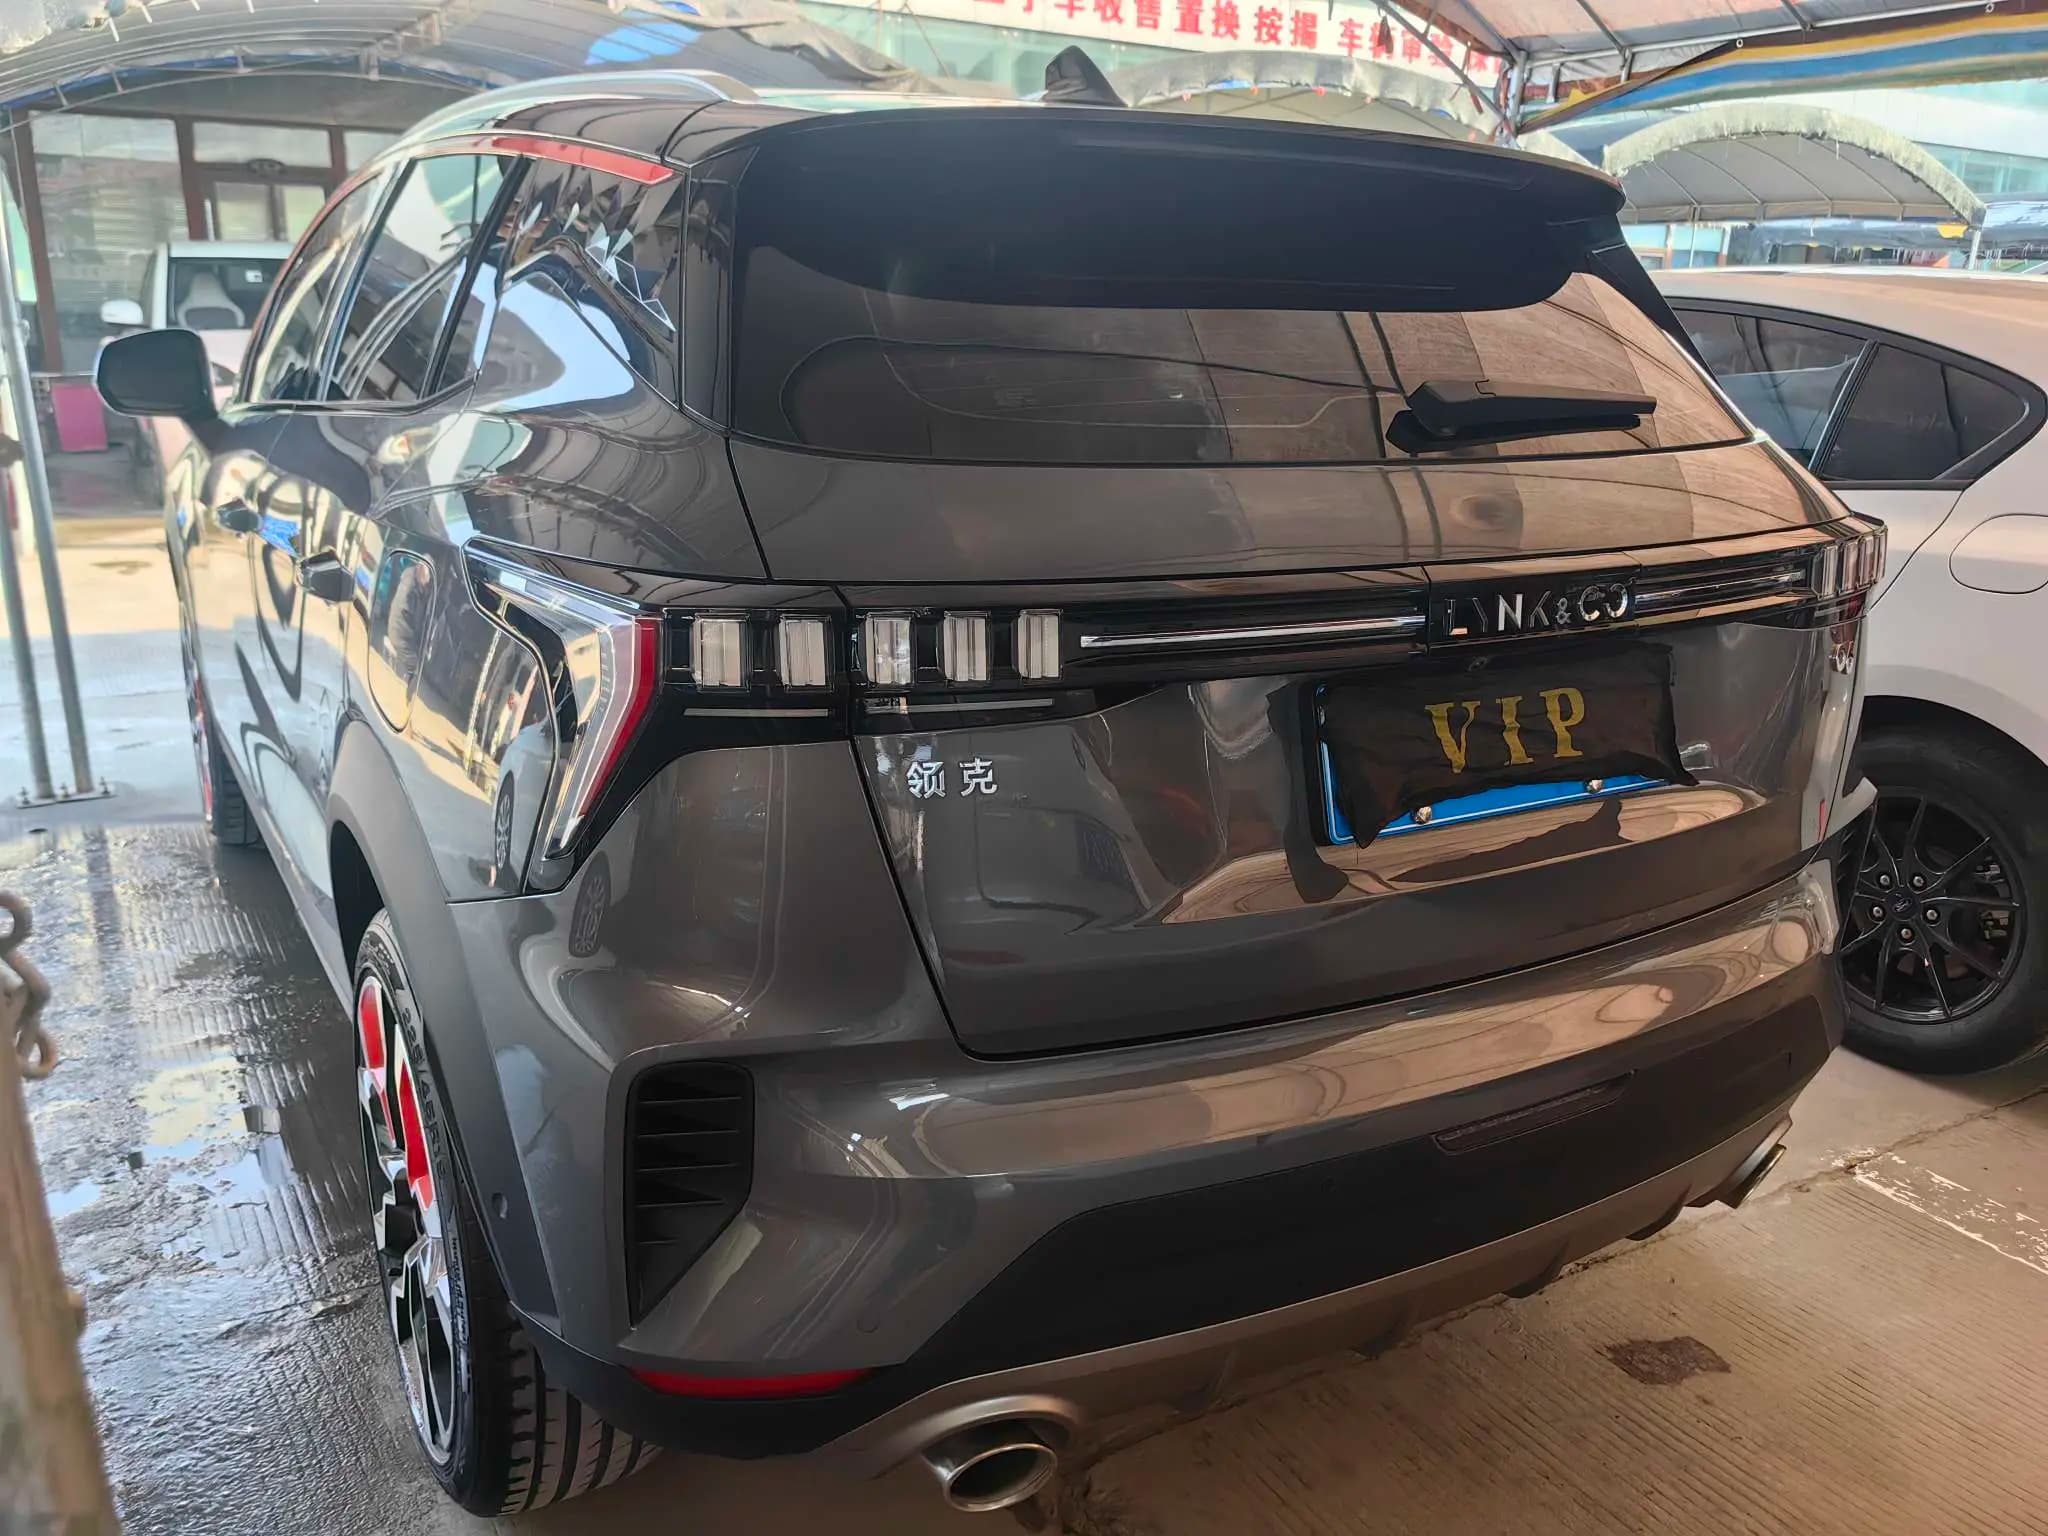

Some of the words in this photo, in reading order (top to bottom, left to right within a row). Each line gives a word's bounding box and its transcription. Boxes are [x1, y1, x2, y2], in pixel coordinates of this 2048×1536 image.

[974, 0, 1240, 40] 收售置换
[1424, 687, 1586, 774] VIP
[906, 757, 999, 799] 领克
